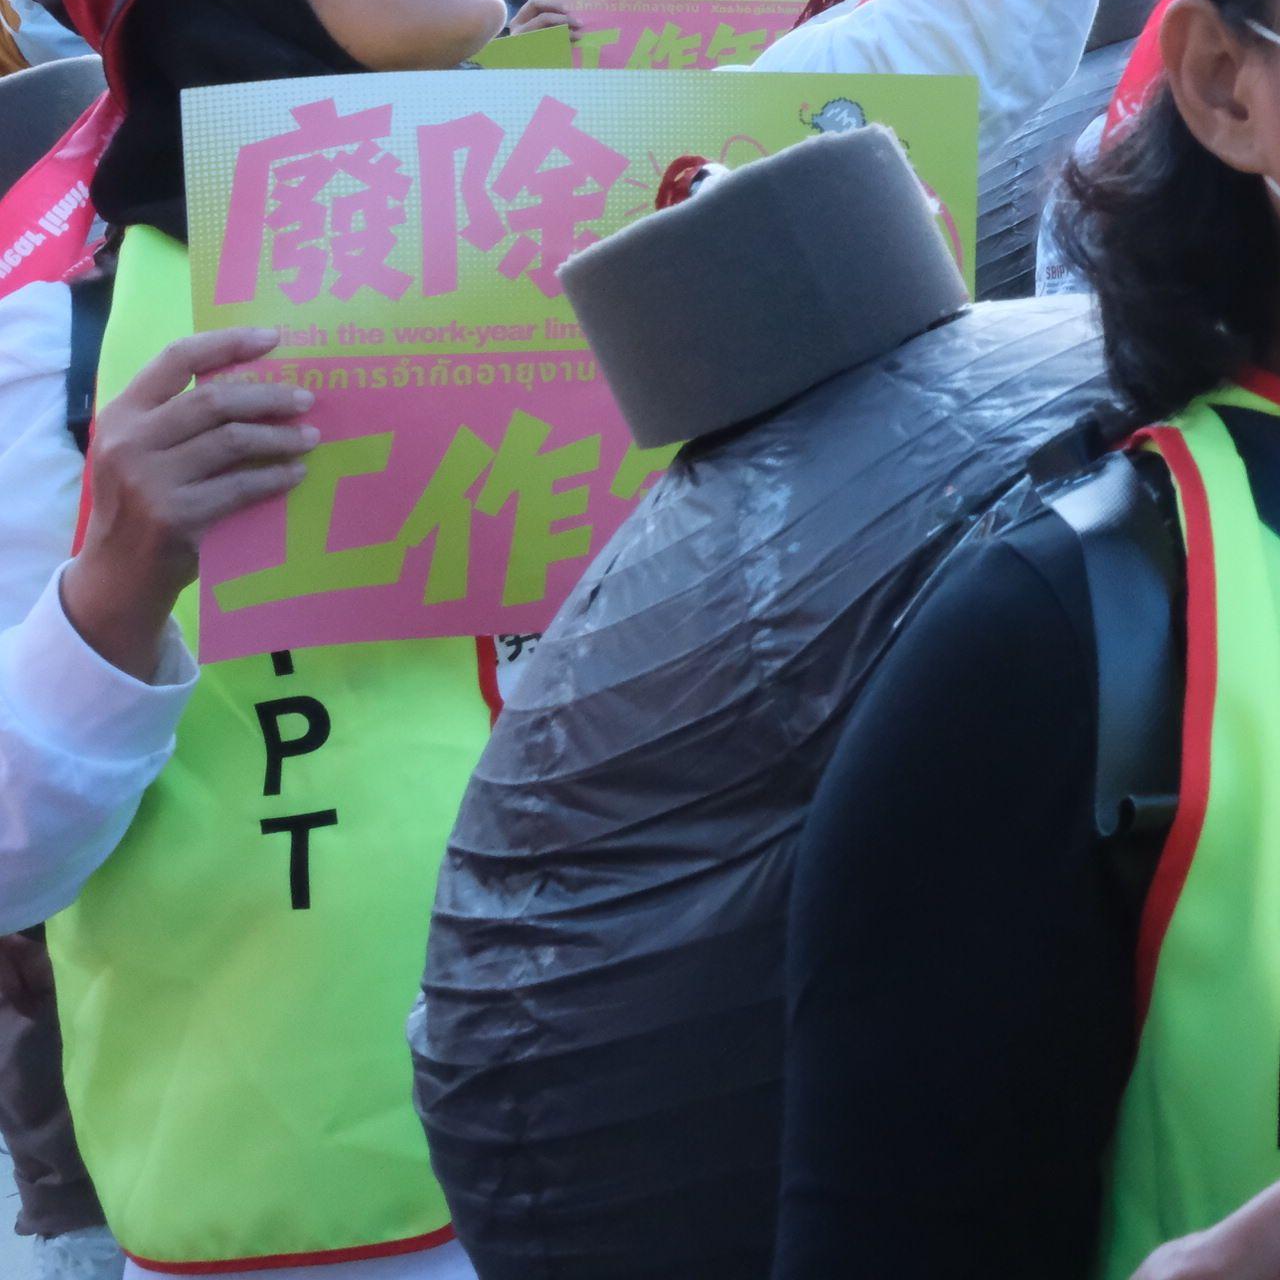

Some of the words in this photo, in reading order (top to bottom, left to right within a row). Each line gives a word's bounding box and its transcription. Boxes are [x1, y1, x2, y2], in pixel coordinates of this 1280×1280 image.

[212, 95, 630, 306] 廢除
[279, 322, 328, 348] lish
[338, 320, 385, 347] the
[392, 319, 536, 349] work-year
[543, 317, 590, 340] lim
